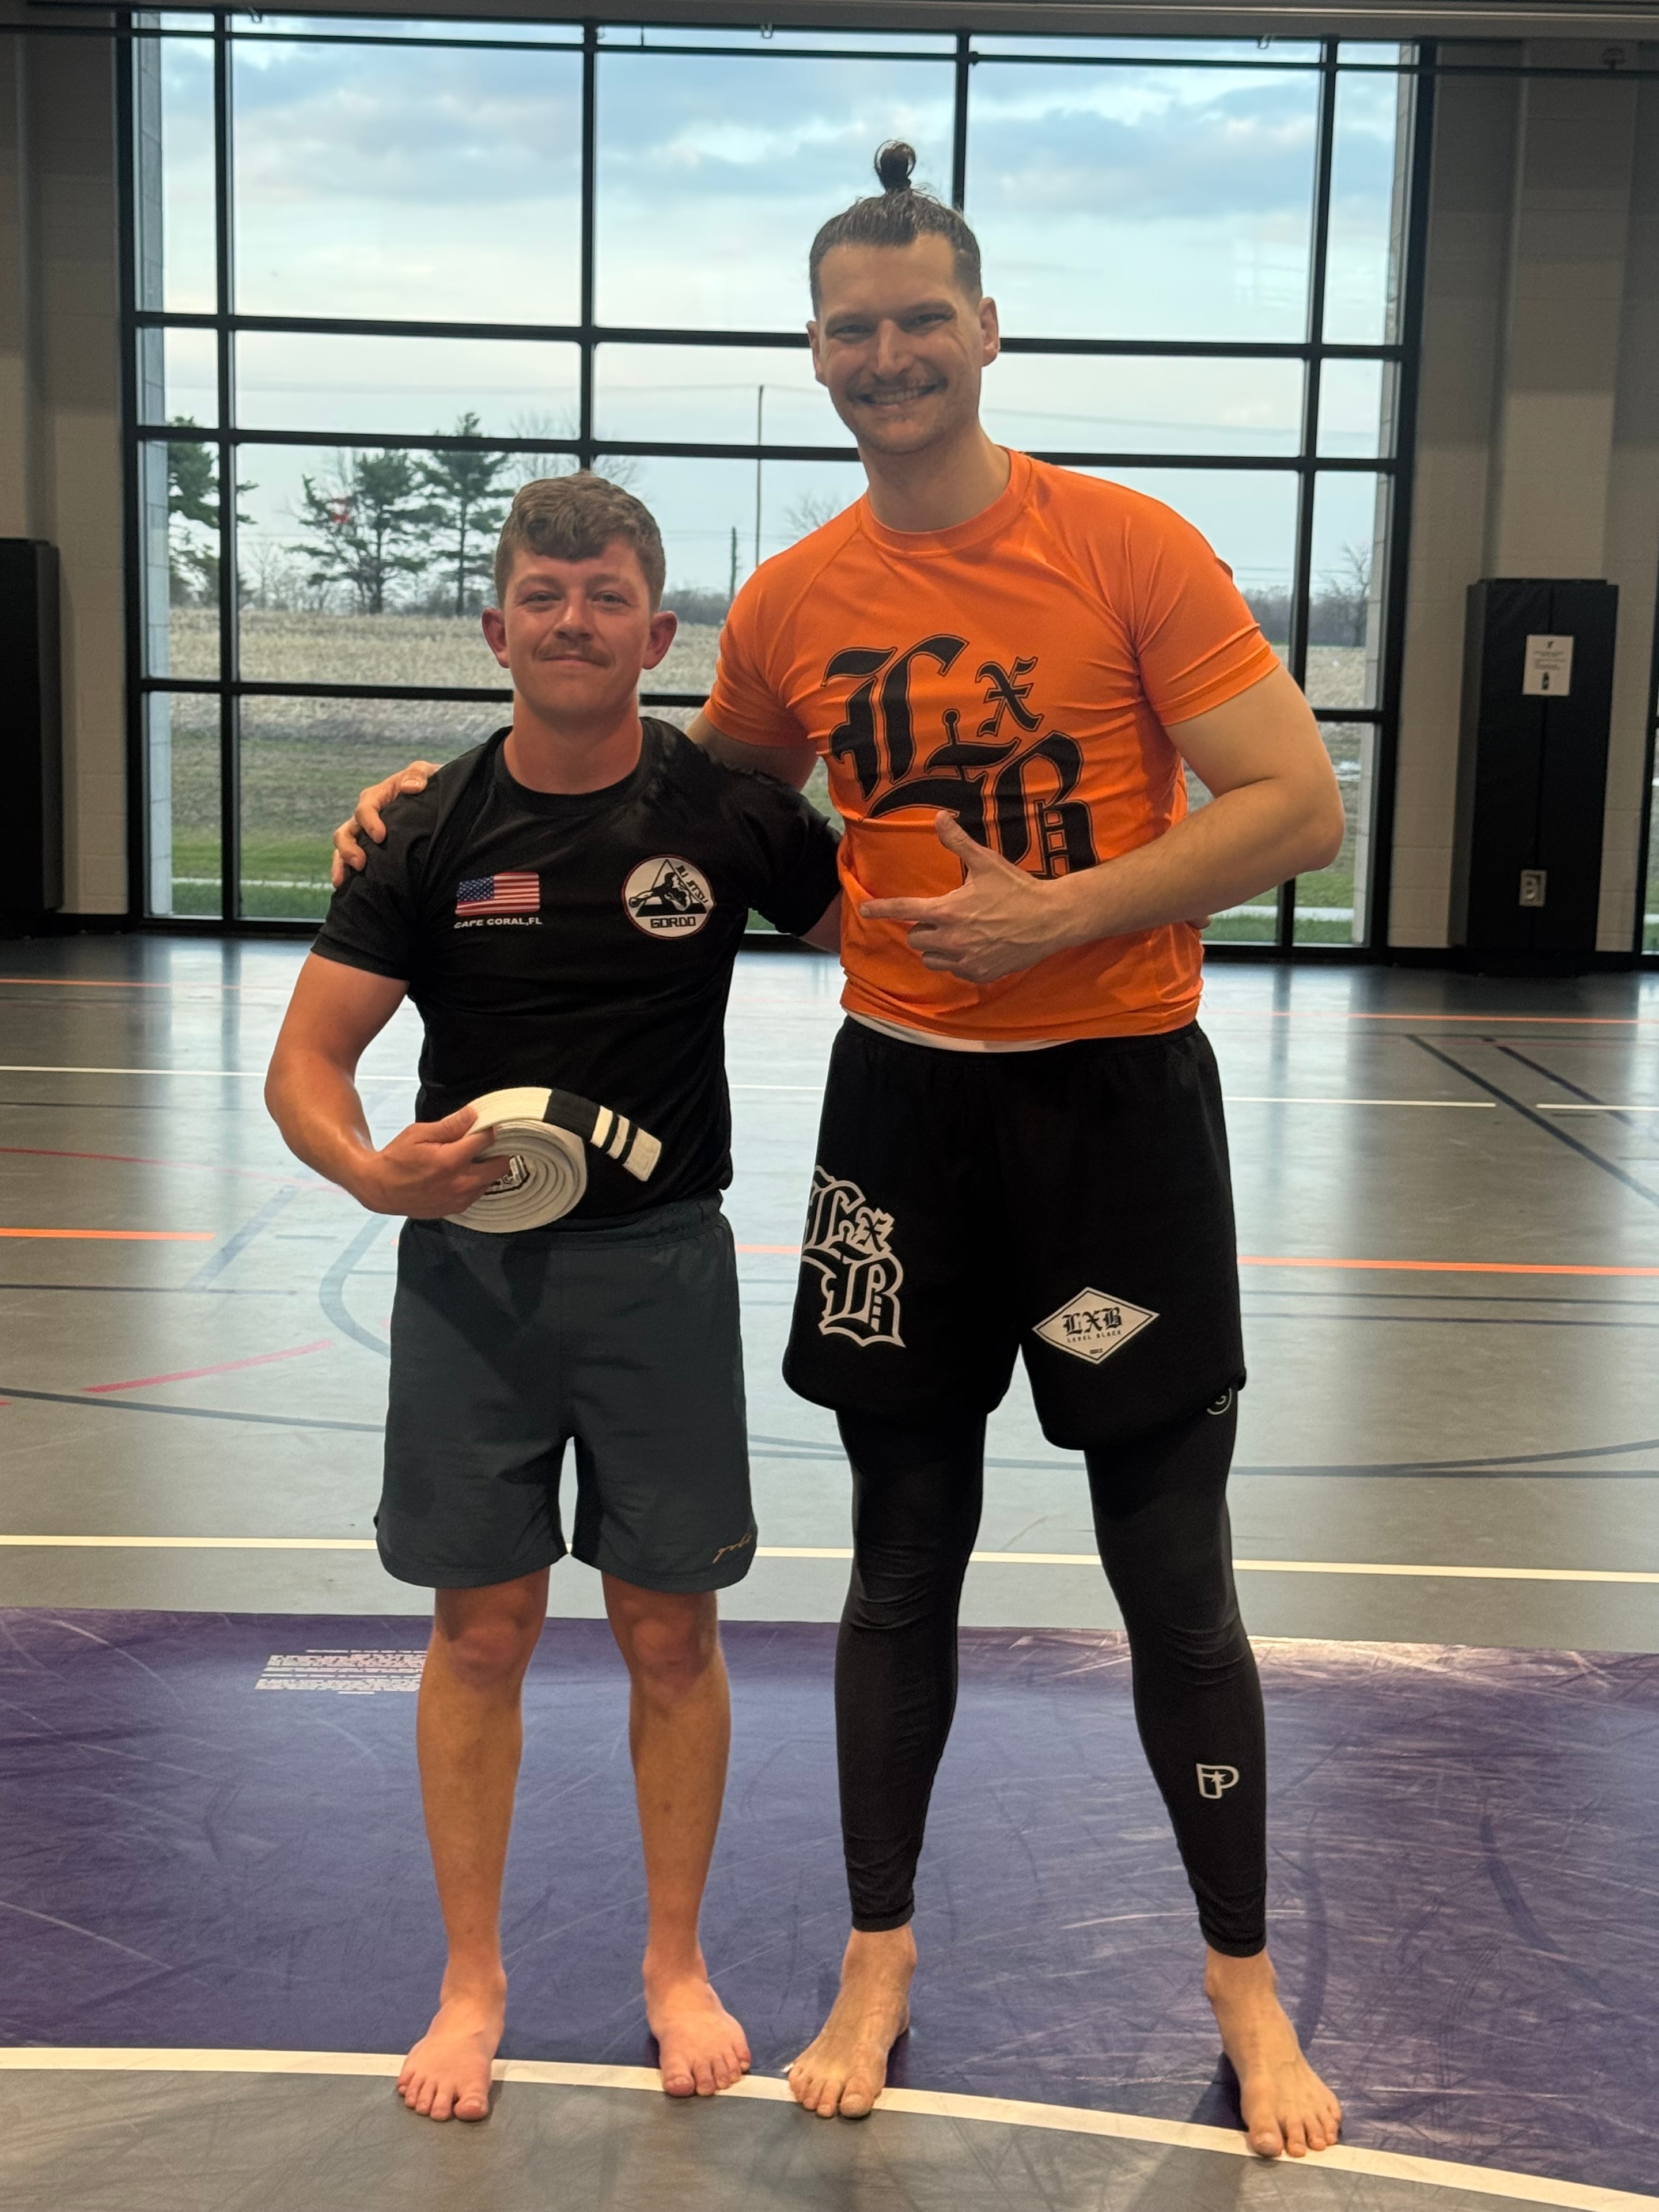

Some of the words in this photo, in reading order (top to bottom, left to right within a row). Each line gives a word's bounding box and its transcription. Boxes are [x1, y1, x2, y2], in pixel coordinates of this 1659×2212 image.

[453, 919, 484, 929] CAPE
[650, 916, 696, 929] GORDO
[1062, 1306, 1122, 1336] LXB
[1097, 1330, 1121, 1338] BLACK
